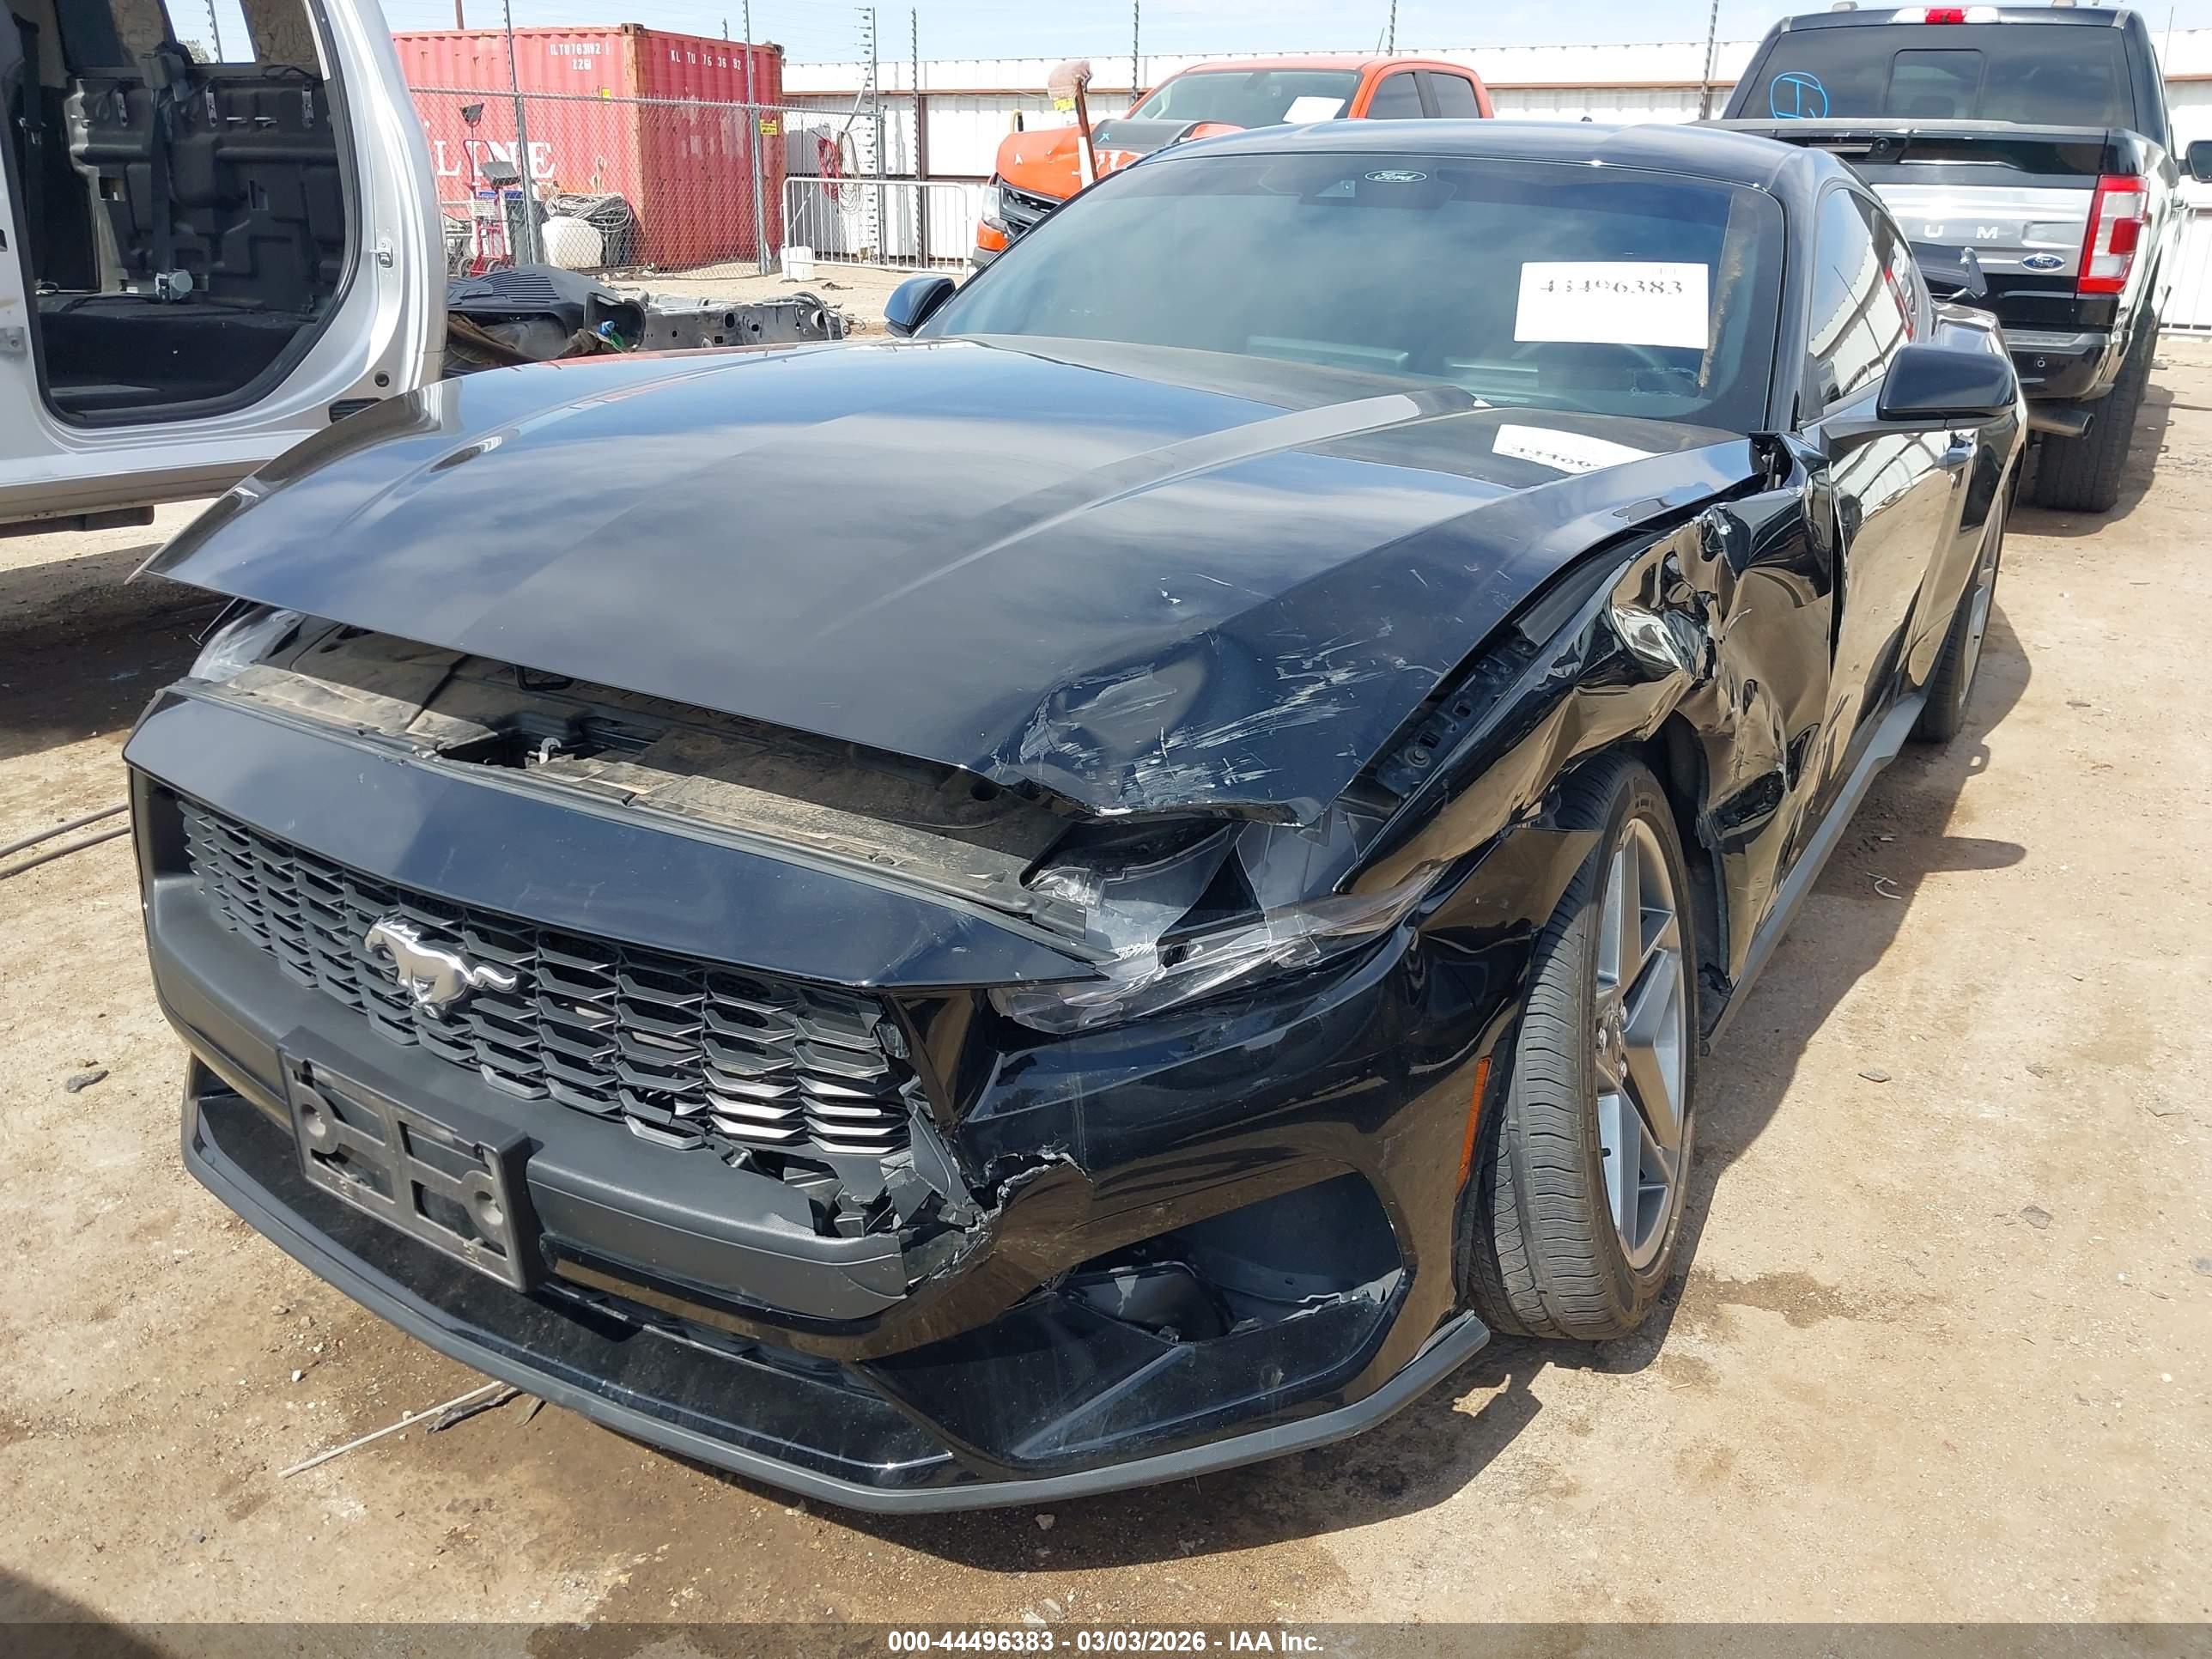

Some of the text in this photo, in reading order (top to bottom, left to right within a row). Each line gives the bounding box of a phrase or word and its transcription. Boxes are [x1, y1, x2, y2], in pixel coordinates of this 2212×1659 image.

[671, 50, 680, 63] KL
[687, 52, 696, 64] TU
[703, 54, 712, 67] 76
[718, 56, 726, 69] 36
[732, 58, 741, 70] 92
[434, 140, 556, 179] LINE
